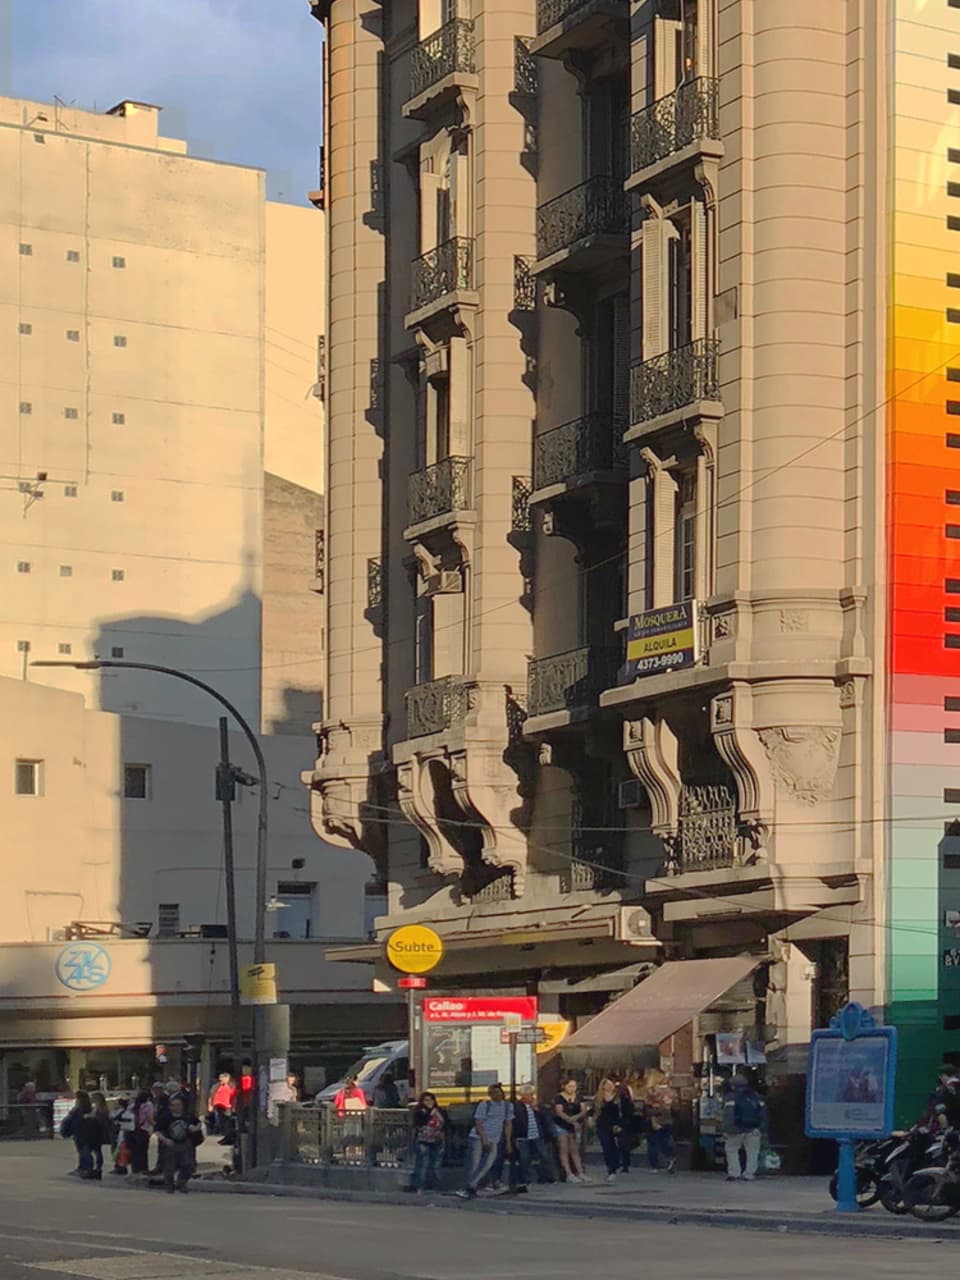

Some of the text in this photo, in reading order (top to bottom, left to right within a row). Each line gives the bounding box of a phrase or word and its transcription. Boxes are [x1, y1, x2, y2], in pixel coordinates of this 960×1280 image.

[644, 637, 677, 652] ALQUILA
[394, 941, 435, 953] Subte
[429, 1001, 463, 1011] Callao
